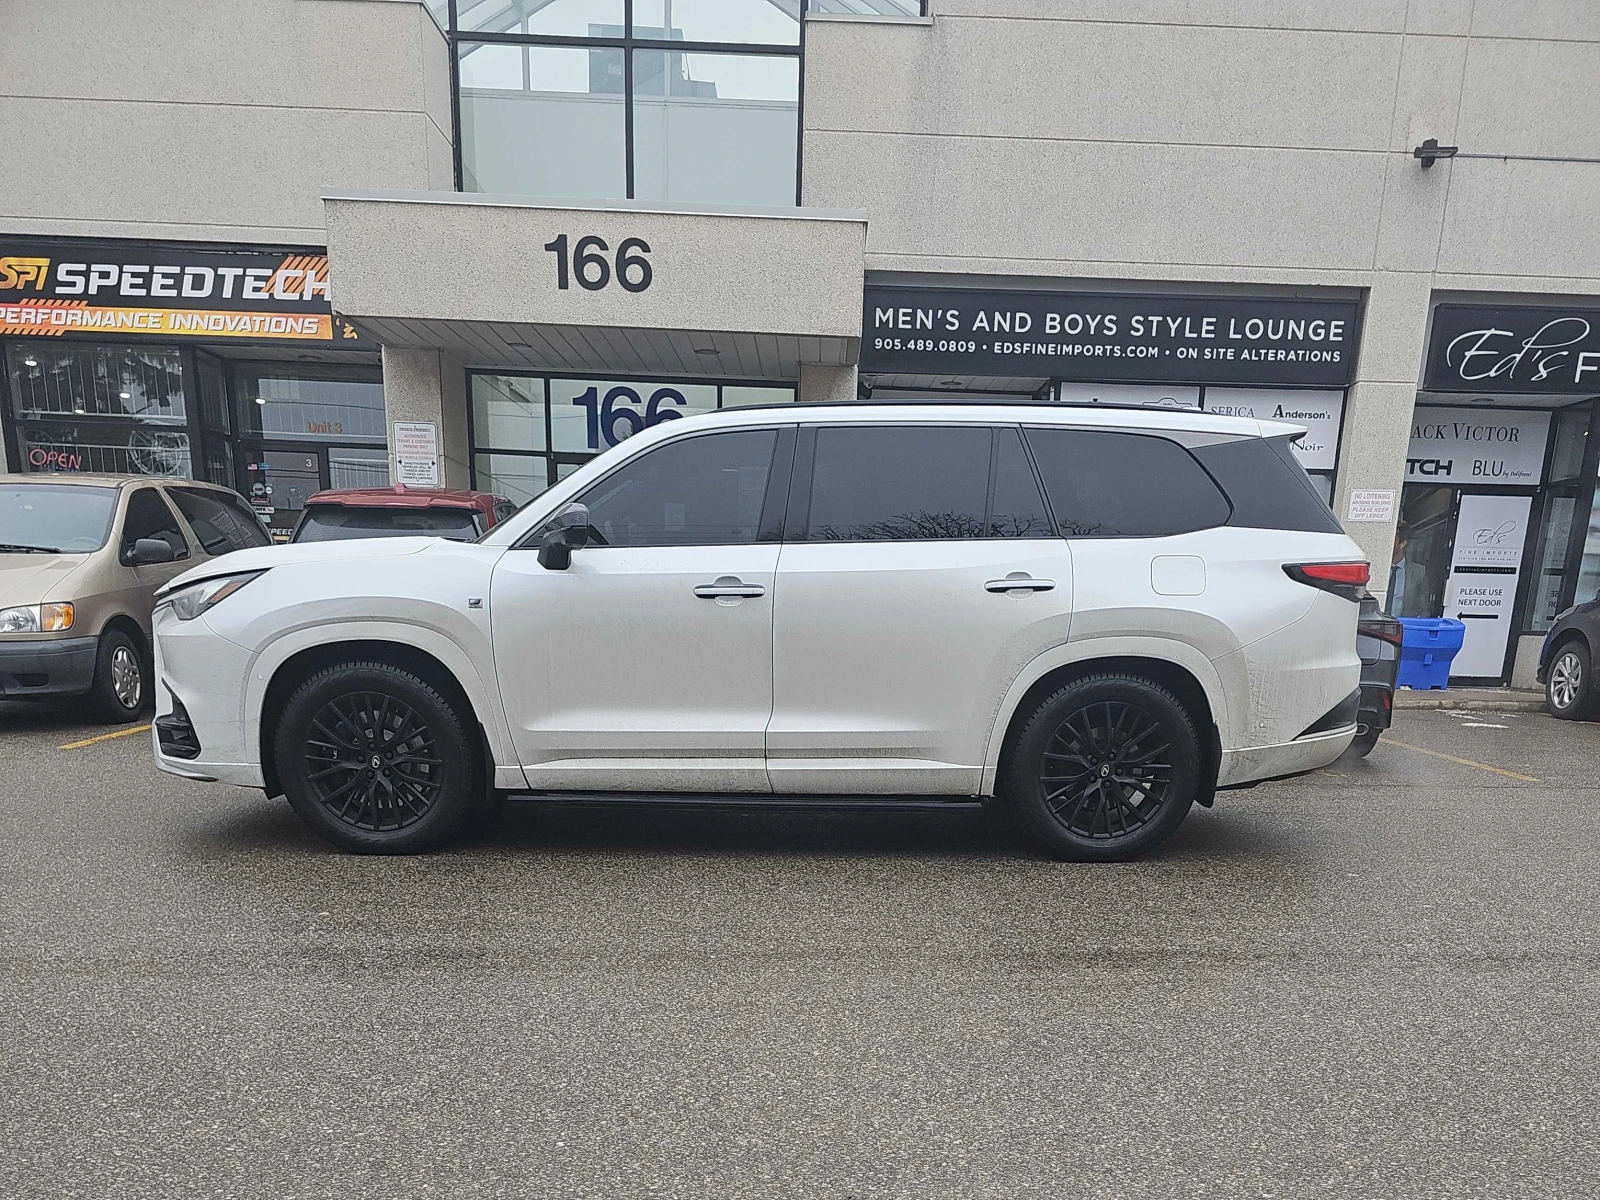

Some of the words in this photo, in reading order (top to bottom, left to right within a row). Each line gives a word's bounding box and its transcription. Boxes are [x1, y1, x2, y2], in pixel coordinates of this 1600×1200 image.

[544, 233, 653, 293] 166
[55, 262, 332, 302] SPEEDTECH
[169, 313, 319, 335] INNOVATIONS
[875, 307, 960, 331] MEN'S
[972, 310, 1032, 333] AND
[1045, 313, 1117, 336] BOYS
[1130, 315, 1217, 338] STYLE
[1229, 318, 1345, 341] LOUNGE
[874, 338, 976, 353] 905.489.0809
[994, 342, 1158, 358] EDSFINEIMPORTS.COM
[1177, 347, 1198, 359] ON
[1204, 348, 1235, 360] SITE
[1241, 349, 1341, 362] ALTERATIONS
[1447, 317, 1590, 382] Ed's
[1574, 352, 1600, 383] F
[1211, 405, 1255, 418] SERICA
[1271, 404, 1331, 420] Anderson's
[307, 421, 332, 433] Unit
[334, 421, 343, 434] 3
[1452, 422, 1520, 443] VICTOR
[1291, 439, 1324, 451] Noir
[29, 448, 82, 470] OPEN
[305, 458, 312, 468] 3
[1472, 459, 1504, 477] BLU
[1472, 520, 1517, 545] Ed's
[1459, 587, 1488, 596] PLEASE
[1489, 588, 1503, 596] USE
[1479, 599, 1502, 607] DOOR
